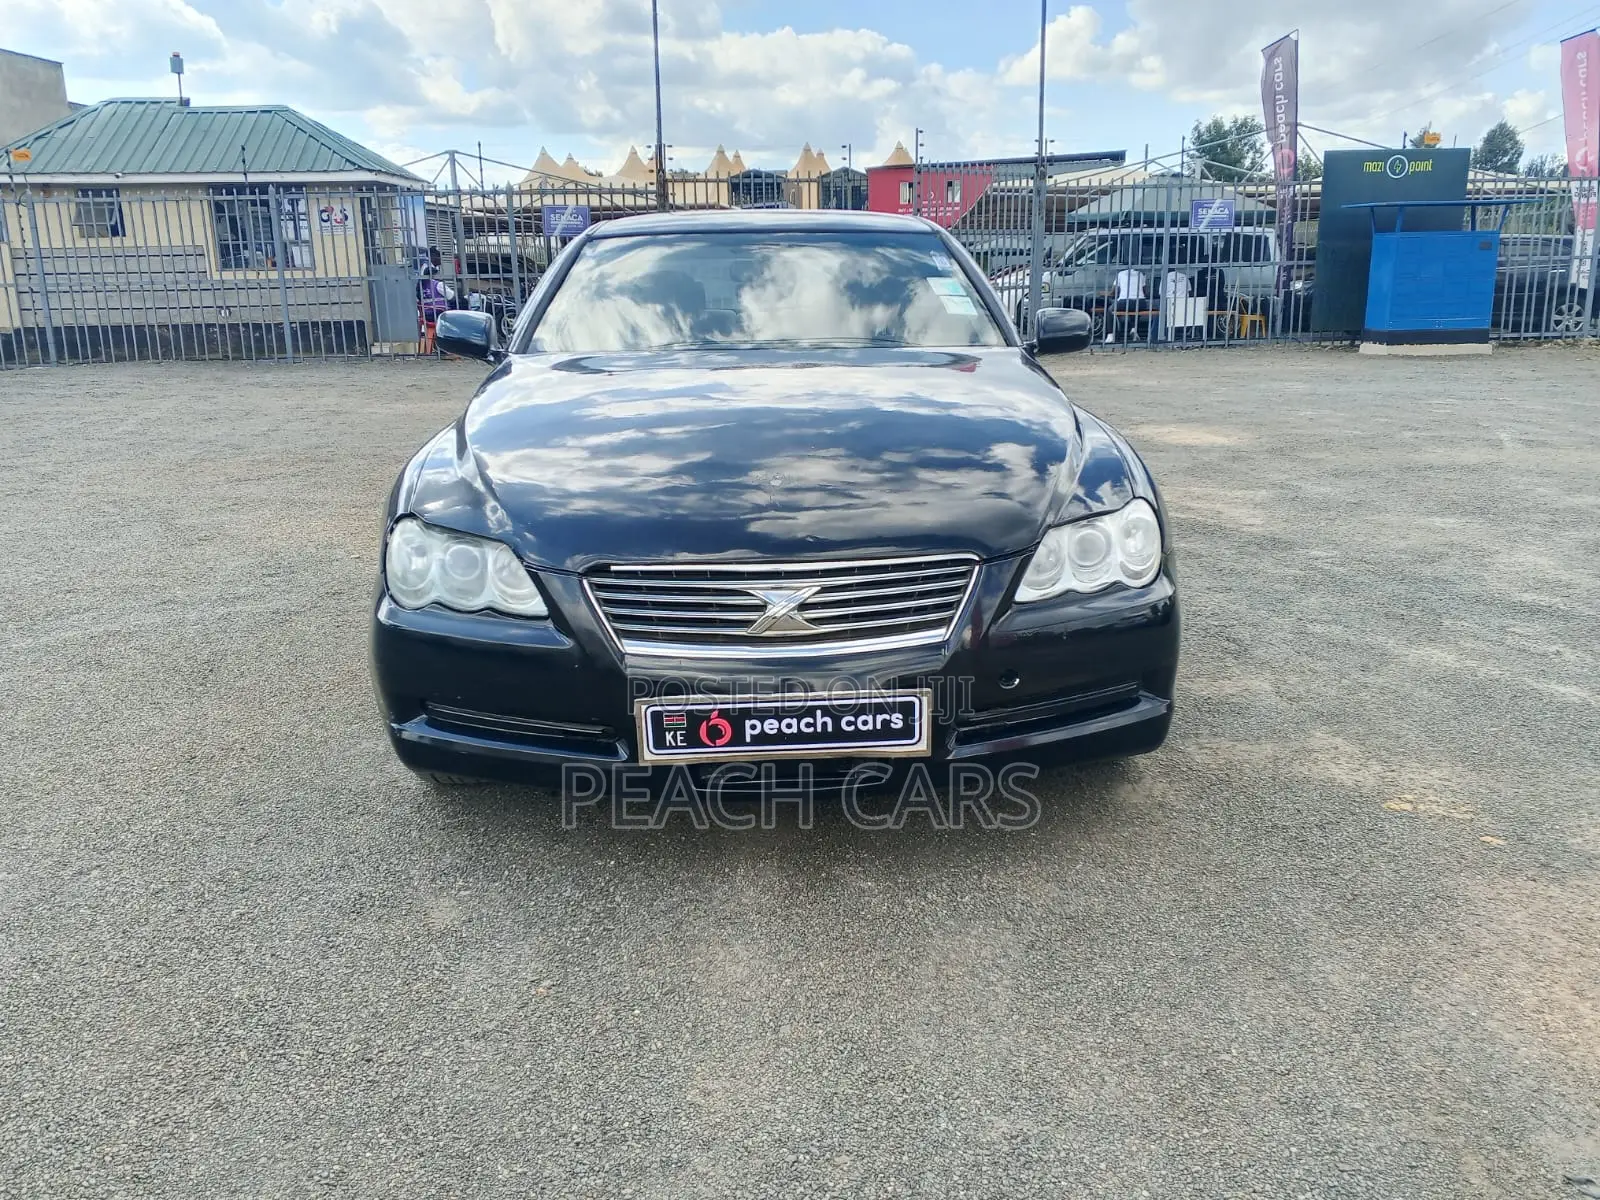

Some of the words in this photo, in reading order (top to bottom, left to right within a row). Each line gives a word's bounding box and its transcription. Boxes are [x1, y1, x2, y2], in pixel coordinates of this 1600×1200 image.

[1408, 159, 1433, 175] point
[320, 206, 349, 224] G4S
[550, 213, 583, 221] SEACA
[1198, 207, 1230, 215] SEACA
[745, 709, 833, 742] peach
[840, 712, 904, 732] cars
[665, 730, 687, 746] KE
